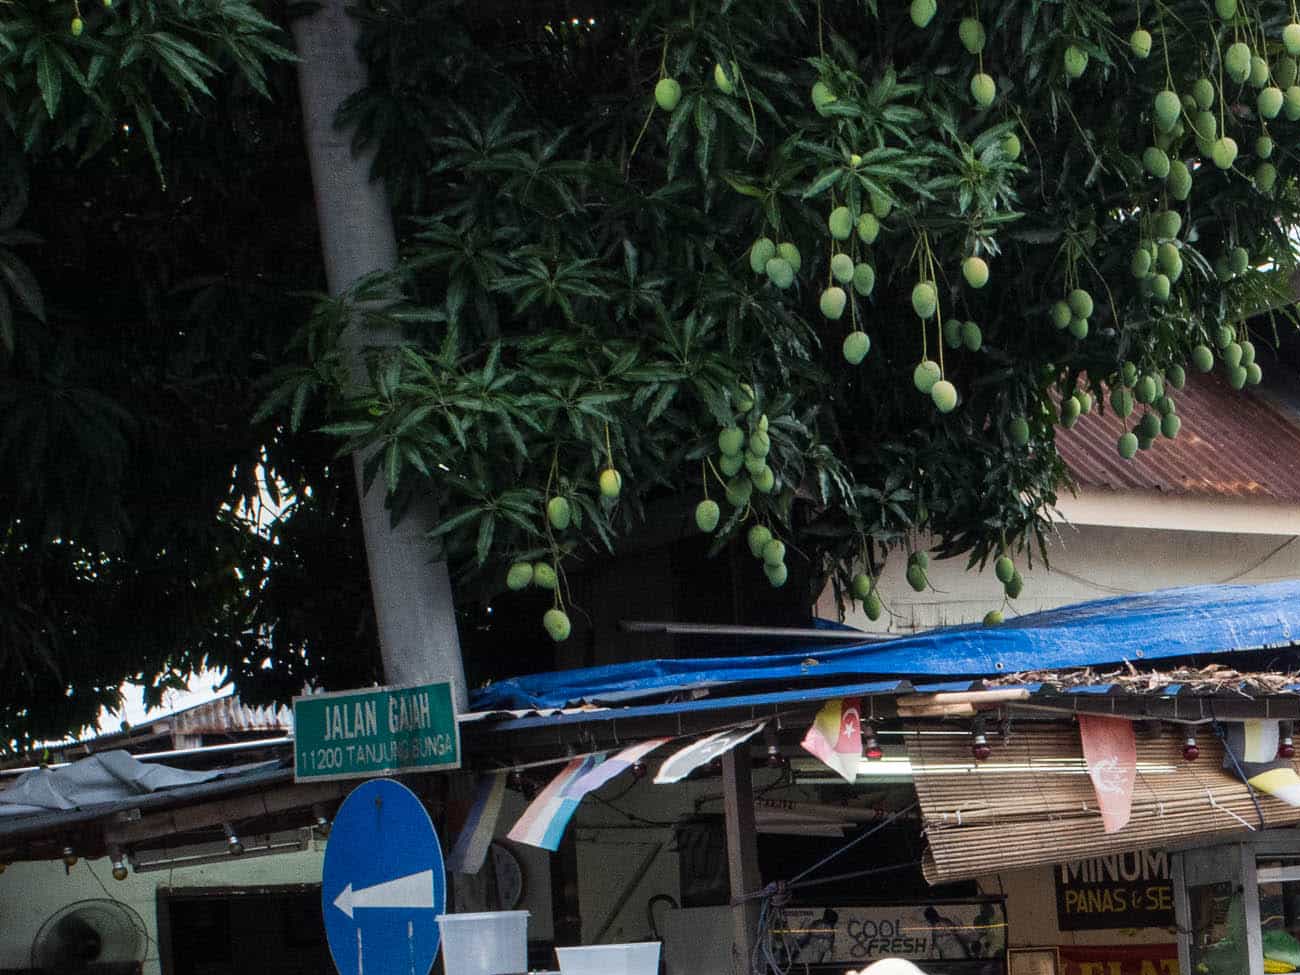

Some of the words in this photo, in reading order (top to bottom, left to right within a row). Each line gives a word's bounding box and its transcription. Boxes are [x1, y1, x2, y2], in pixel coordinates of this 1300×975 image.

[324, 701, 377, 741] JALAN
[388, 692, 431, 734] GAJAH
[302, 748, 343, 770] 11200
[346, 738, 409, 765] TANJUNG
[412, 733, 452, 760] BUNGA
[1061, 847, 1169, 884] MINUM
[1064, 889, 1127, 912] PANAS
[847, 919, 907, 939] COOL
[868, 937, 927, 954] FRESH
